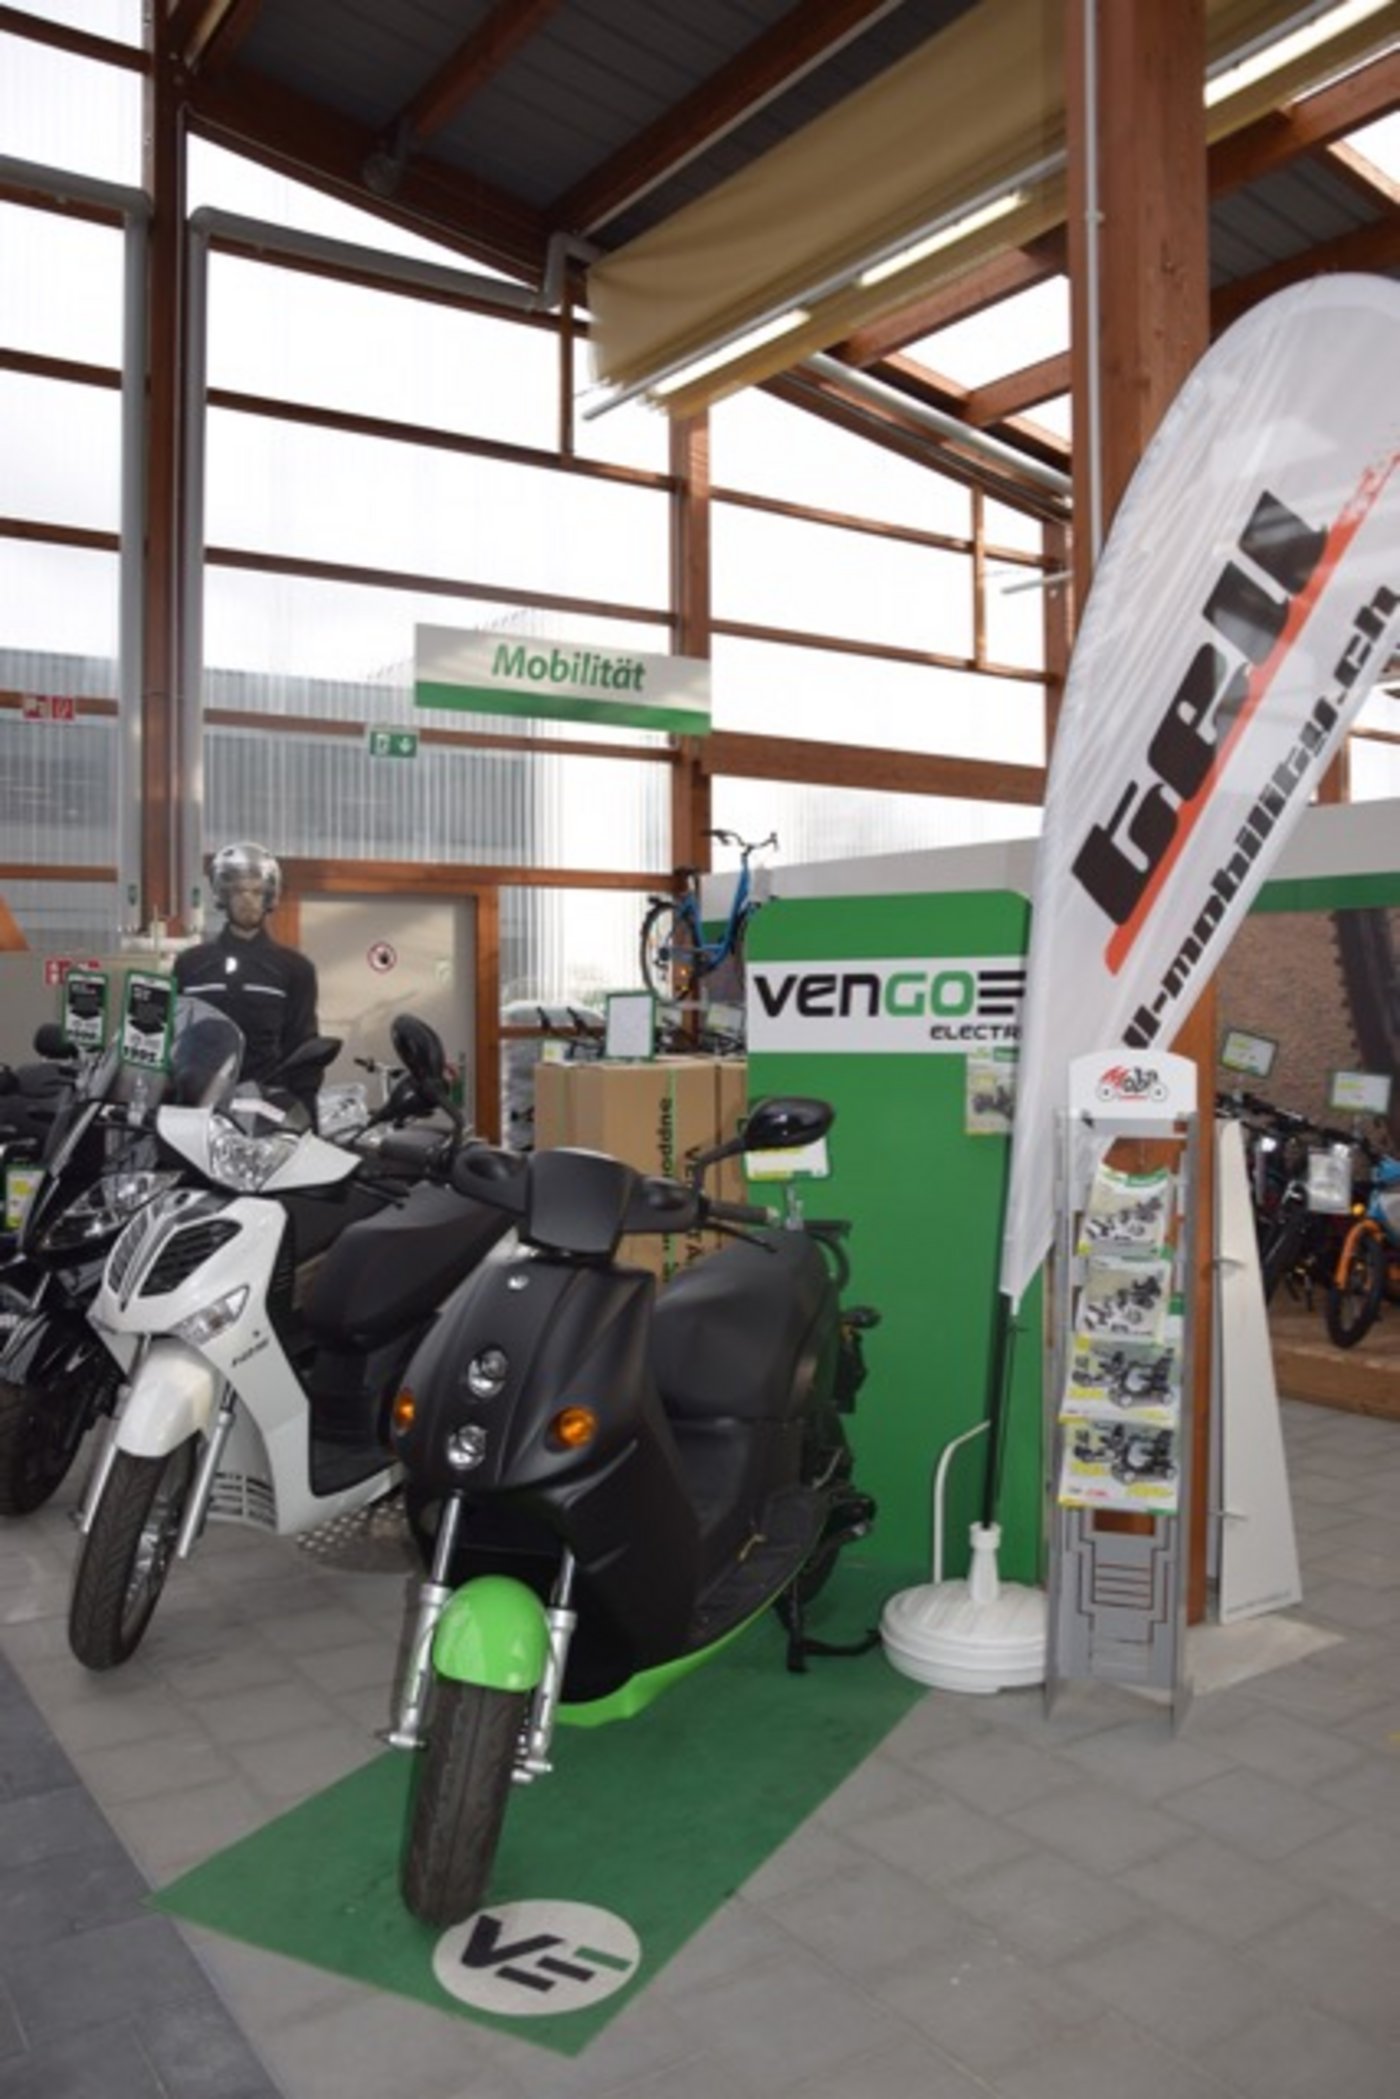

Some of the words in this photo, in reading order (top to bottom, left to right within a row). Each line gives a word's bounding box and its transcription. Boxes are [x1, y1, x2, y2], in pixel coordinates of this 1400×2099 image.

[492, 643, 646, 692] Mobilität
[1071, 490, 1328, 925] tell
[1122, 585, 1400, 1049] ll-mobility.ch
[930, 1024, 1020, 1040] ELECTR
